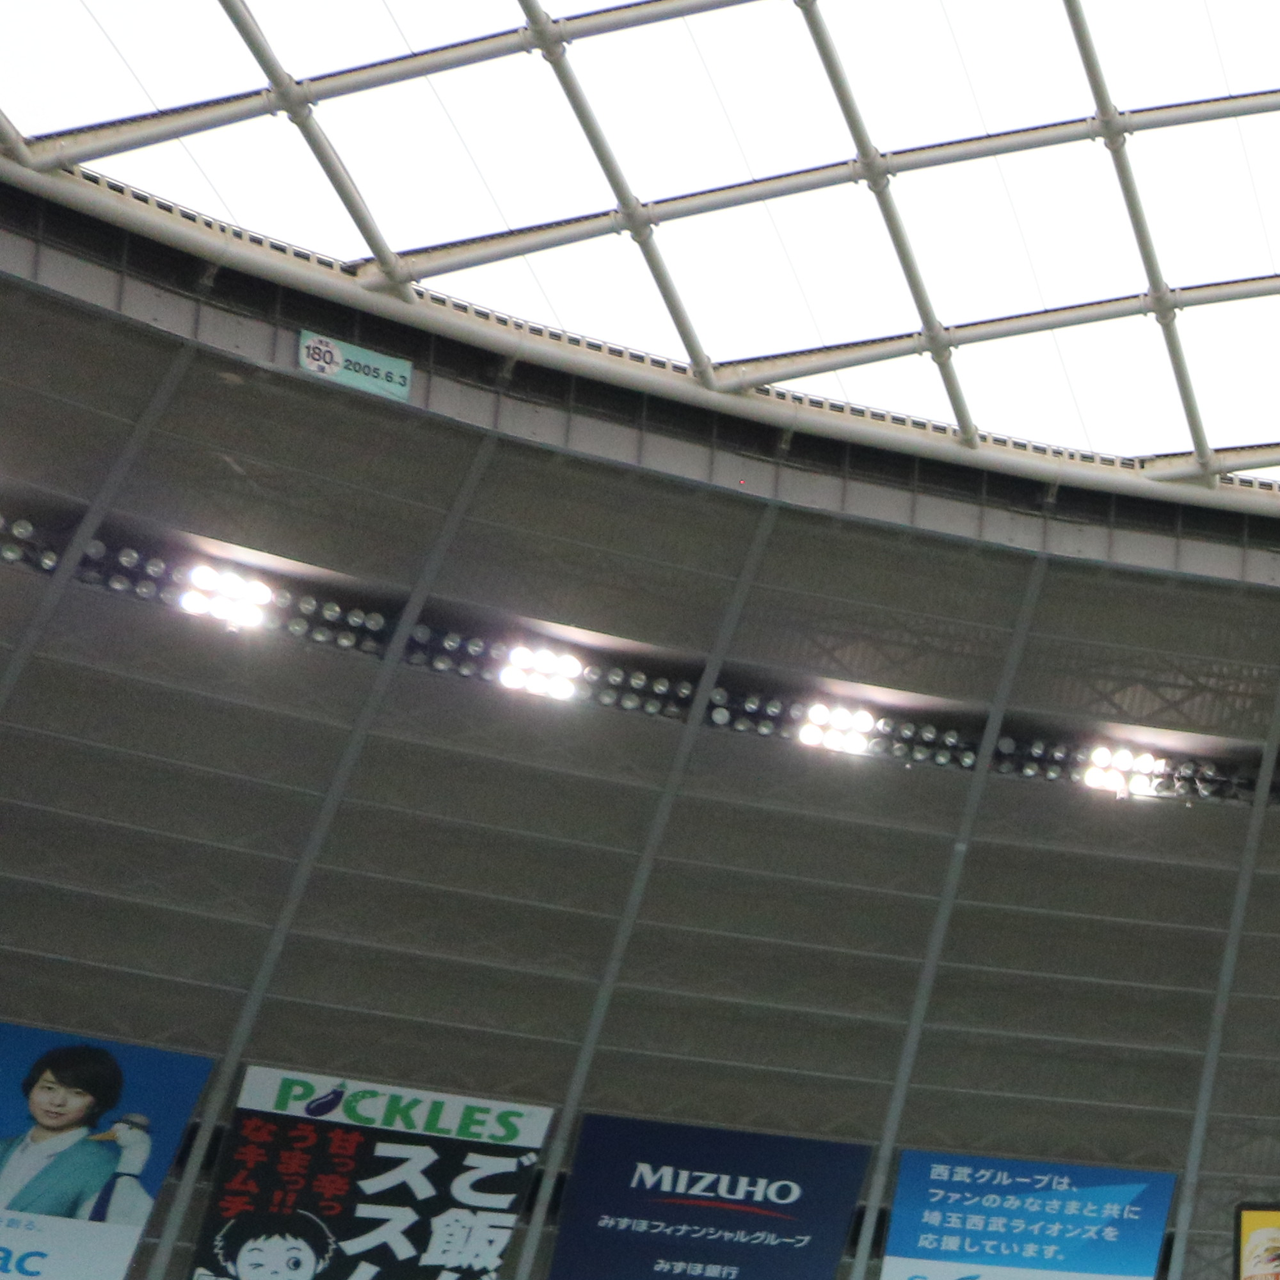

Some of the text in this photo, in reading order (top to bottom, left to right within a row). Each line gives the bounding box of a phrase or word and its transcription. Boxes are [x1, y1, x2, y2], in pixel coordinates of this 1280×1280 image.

[218, 1117, 278, 1218] なキムチ
[630, 1162, 802, 1204] MIZUHO
[929, 1163, 1078, 1192] 西武グループは、
[928, 1188, 1142, 1220] ファンのみなさまと共に
[597, 1215, 811, 1247] みずほフィナンシャルグループ
[921, 1209, 1119, 1241] 埼玉西武ライオンズを
[917, 1233, 1065, 1261] 応援しています。
[653, 1259, 740, 1279] みずほ銀行
